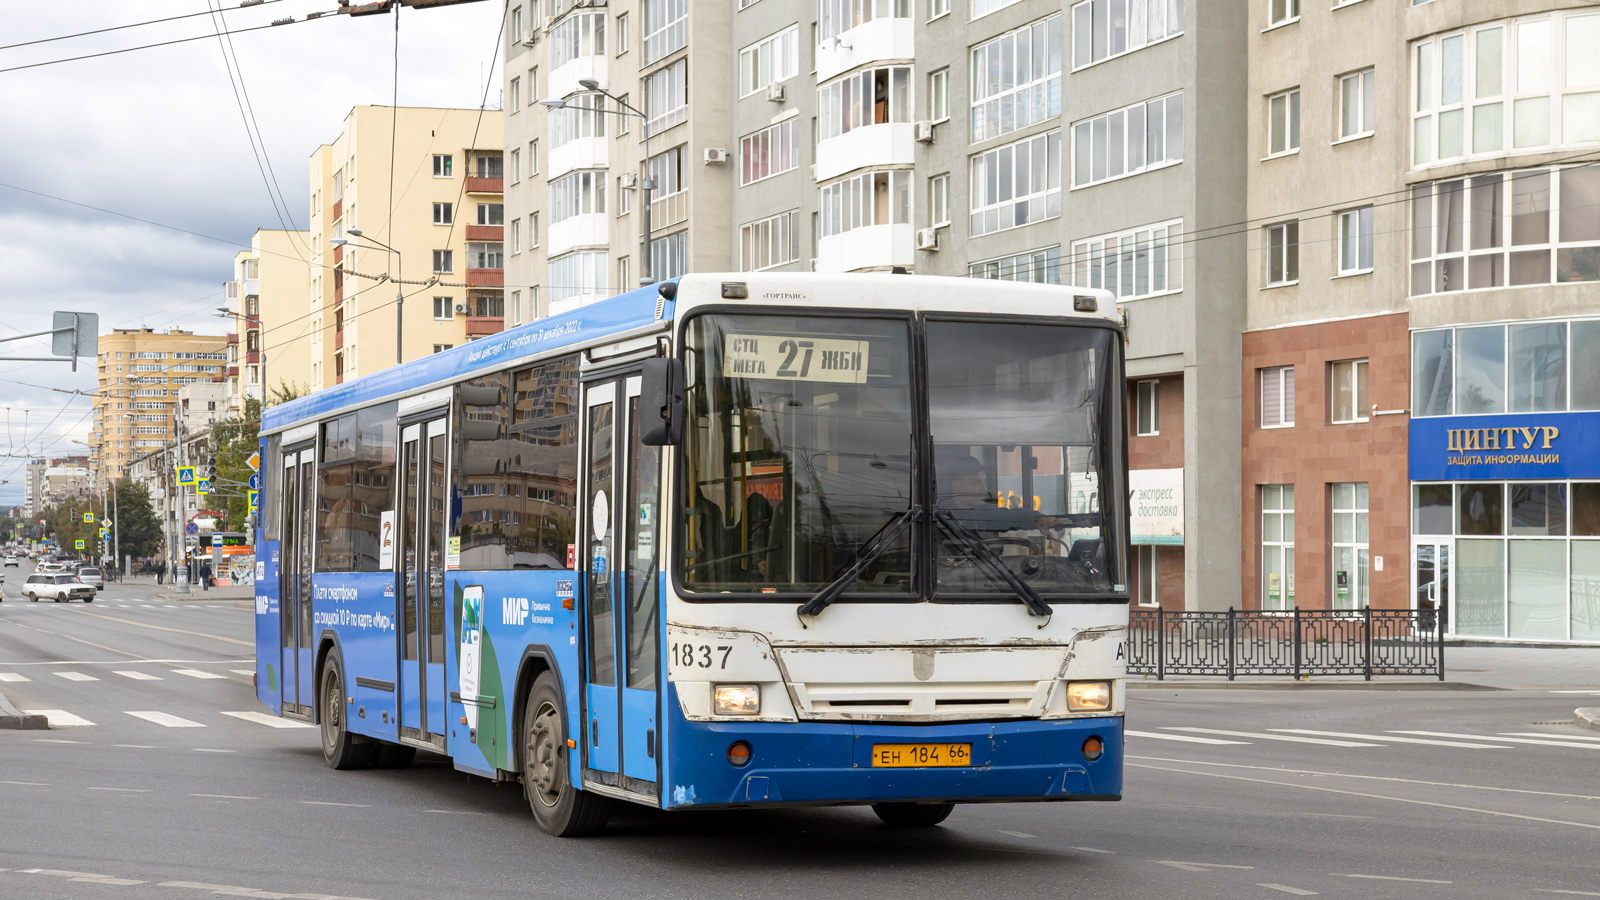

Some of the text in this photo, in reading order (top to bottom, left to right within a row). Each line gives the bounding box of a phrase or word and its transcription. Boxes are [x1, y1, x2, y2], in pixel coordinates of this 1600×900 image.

[762, 292, 807, 300] «ГОРТРАНС»
[468, 350, 482, 361] Акция
[481, 343, 504, 359] действует
[510, 333, 531, 349] сентября
[531, 334, 538, 343] по
[538, 329, 544, 342] 31
[543, 324, 564, 342] декабря
[564, 320, 578, 336] 2022
[733, 338, 759, 355] СТЦ
[733, 358, 766, 375] МЕГА
[776, 339, 862, 378] 27 ЖБИ
[1446, 426, 1560, 456] ЦИНТУР
[1447, 454, 1560, 466] ЗАЩИТА ИНФОРМАЦИИ
[1138, 487, 1174, 501] экспресс
[1138, 502, 1178, 517] доставка
[313, 584, 358, 603] Плати смартфоном
[502, 597, 529, 626] МИР
[531, 600, 551, 612] Привычно
[314, 611, 320, 625] со
[320, 608, 339, 627] скидкой
[339, 609, 346, 626] 10
[350, 613, 357, 627] по
[358, 614, 372, 631] карте
[531, 613, 554, 625] безналично
[672, 642, 733, 670] 1837
[909, 746, 939, 763] 184
[949, 745, 965, 758] 66
